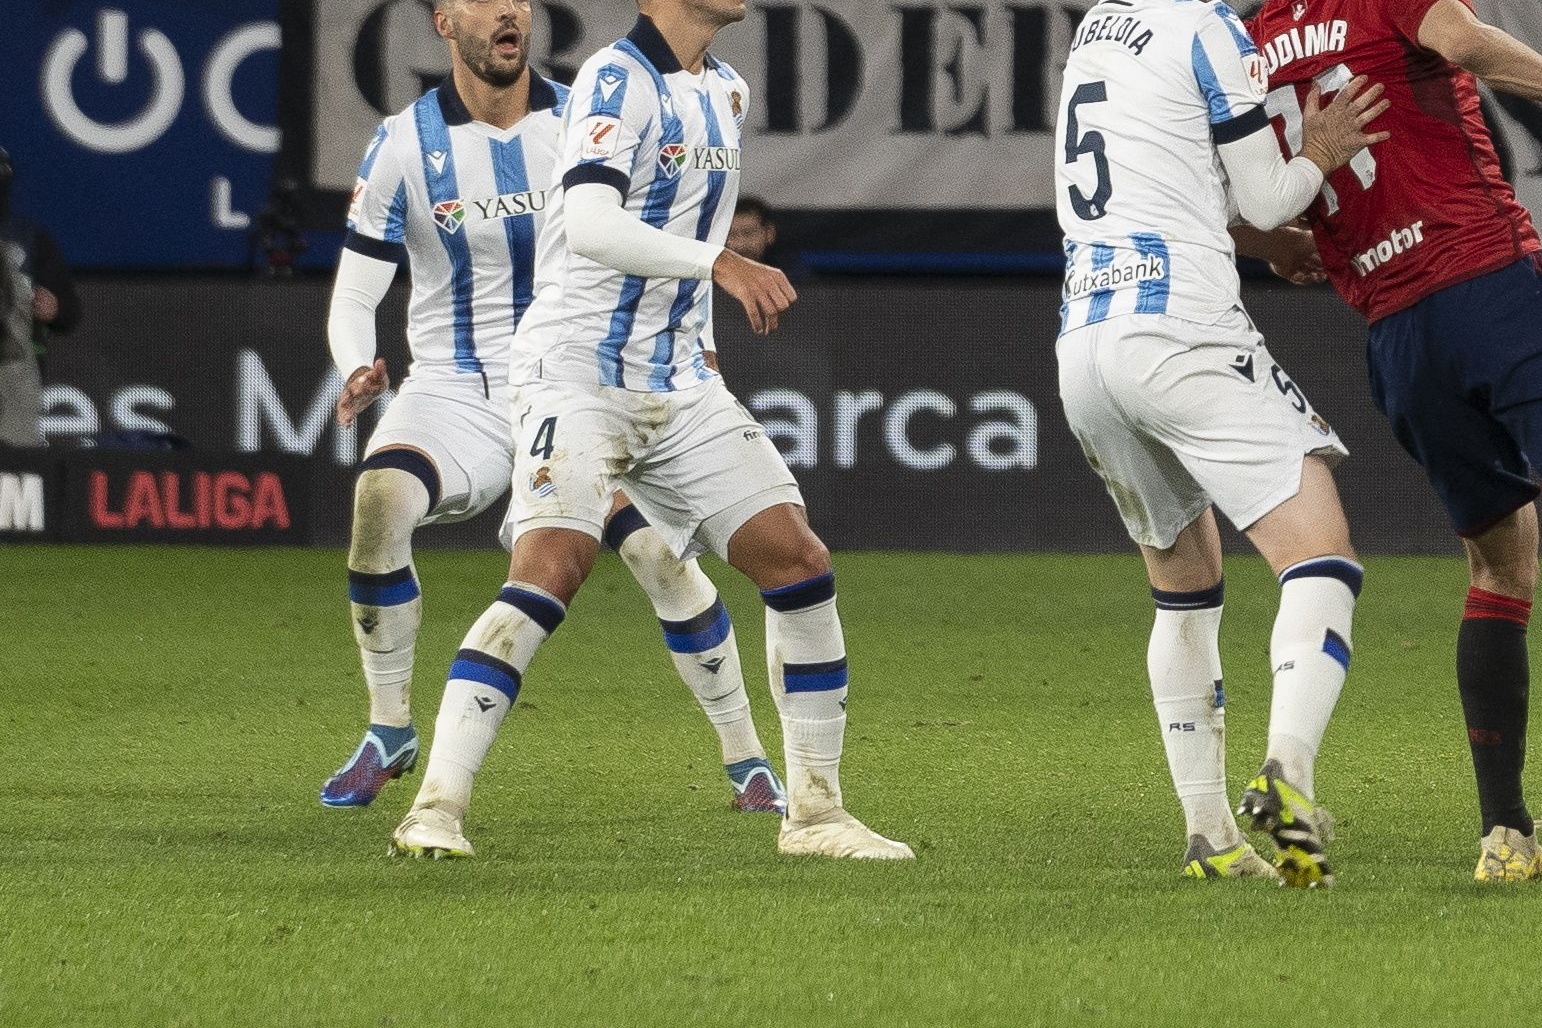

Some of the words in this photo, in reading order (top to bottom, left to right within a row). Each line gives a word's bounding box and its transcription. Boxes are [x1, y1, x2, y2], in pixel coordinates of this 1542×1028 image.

[1071, 16, 1154, 55] UBELDIA
[1262, 20, 1348, 75] UDIMIR
[1065, 80, 1113, 220] 5
[473, 189, 547, 220] YASU
[1270, 363, 1307, 414] 5
[529, 416, 558, 461] 4
[87, 471, 291, 531] LALIGA
[1169, 722, 1196, 732] RS
